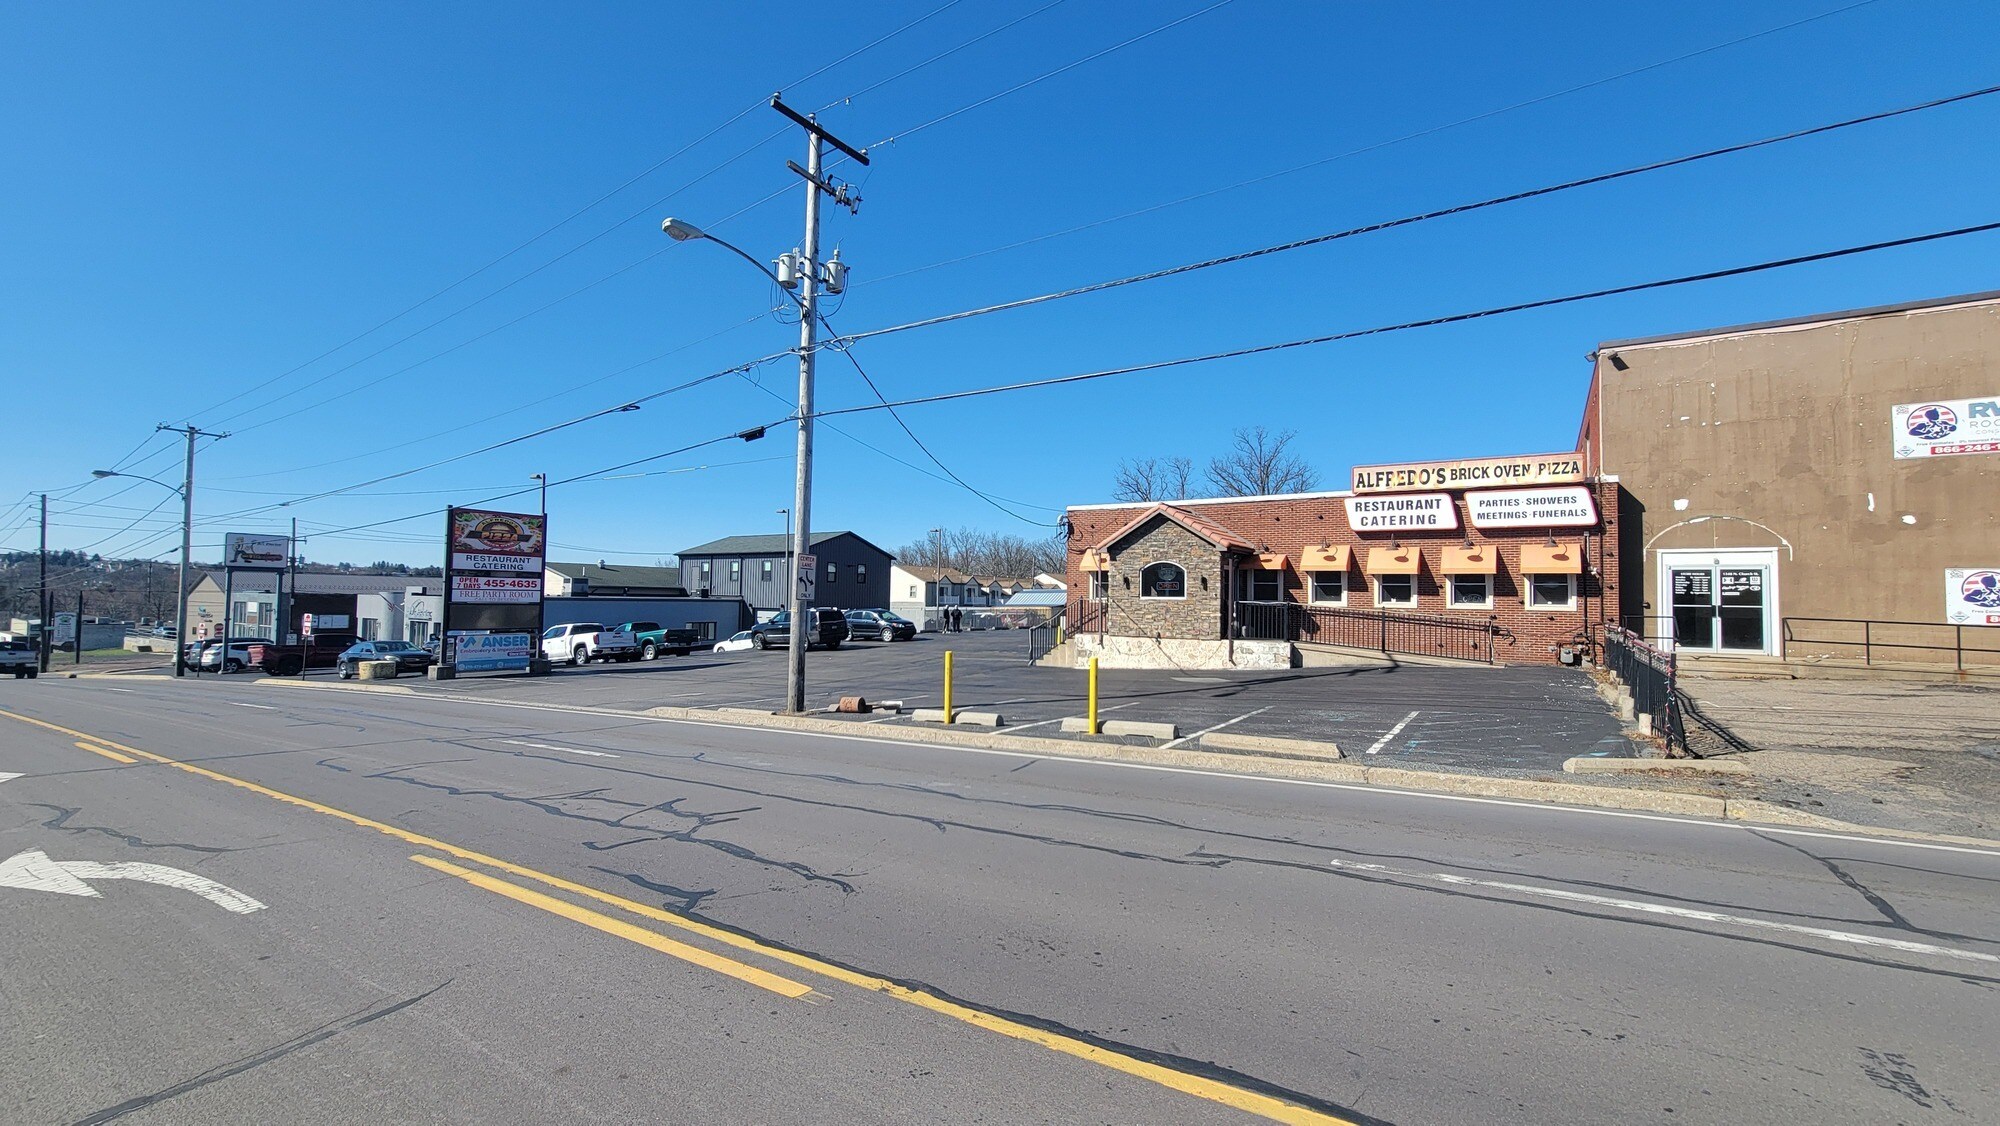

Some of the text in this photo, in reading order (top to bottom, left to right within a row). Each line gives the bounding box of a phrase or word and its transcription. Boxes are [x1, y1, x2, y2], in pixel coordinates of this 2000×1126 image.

[1356, 461, 1580, 489] ALFREDO'S BRICK OVEN PIZZA
[1354, 498, 1442, 513] RESTAURANT
[1479, 496, 1577, 508] PARTIES SHOWERS
[1477, 508, 1587, 520] MEETINGS FUNERALS
[1360, 514, 1437, 527] CATERING
[481, 531, 518, 541] PIZZA
[466, 554, 531, 564] RESTAURANT
[473, 562, 524, 570] CATERING
[484, 579, 538, 588] 455-4635
[460, 590, 480, 598] FREE
[481, 635, 528, 648] ANSER
